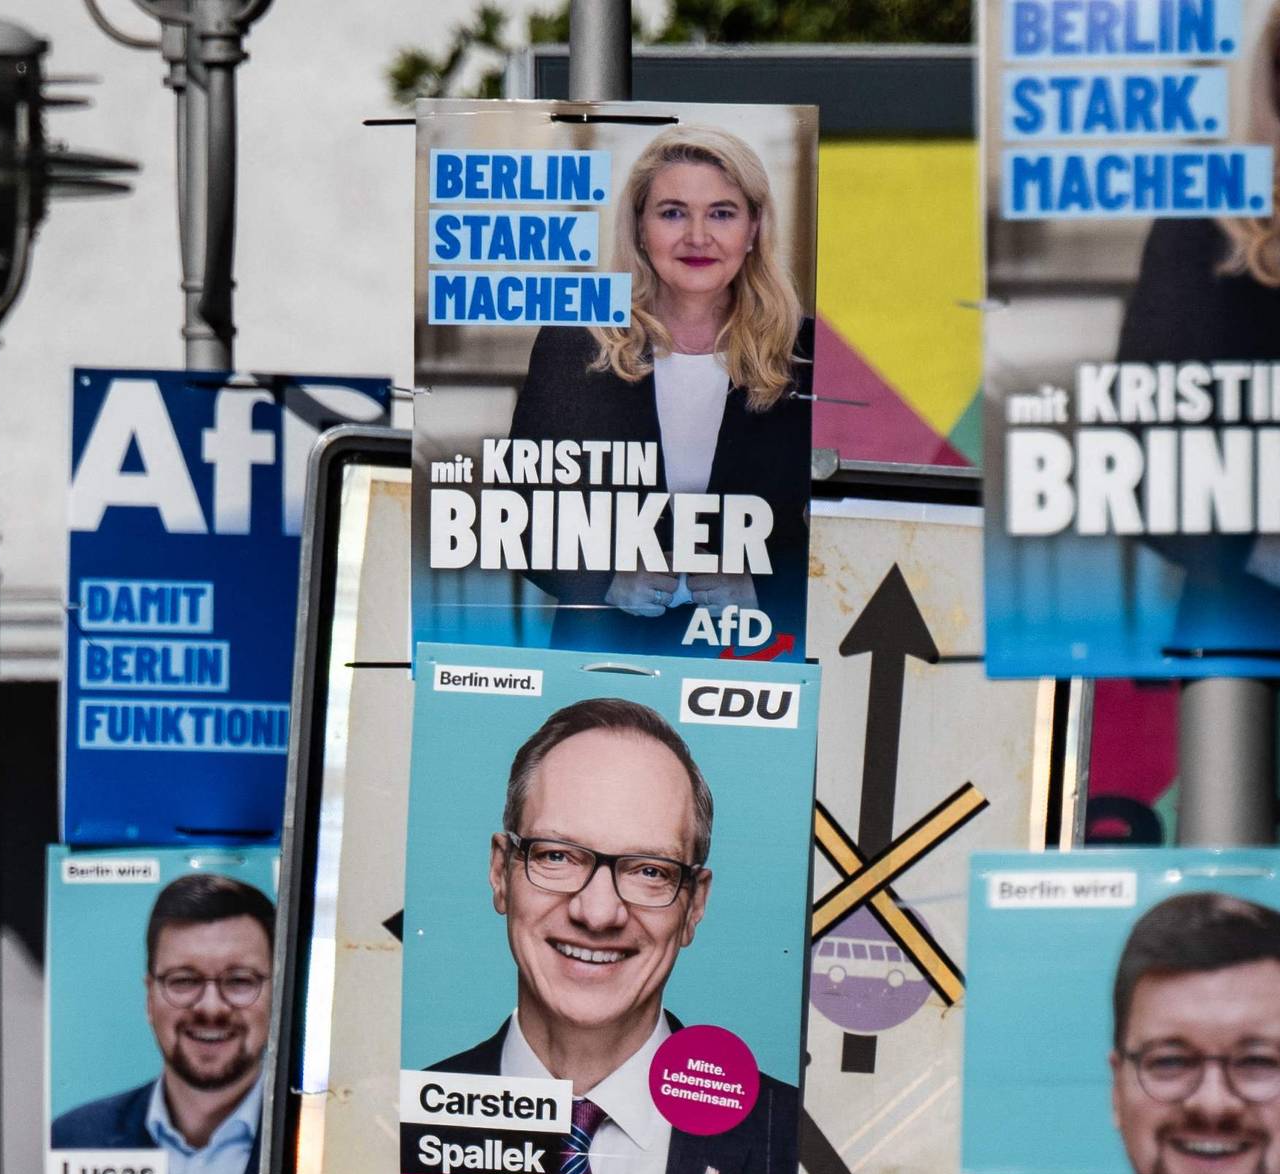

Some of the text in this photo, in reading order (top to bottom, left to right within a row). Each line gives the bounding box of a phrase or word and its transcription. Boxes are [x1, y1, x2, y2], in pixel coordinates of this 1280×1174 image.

[1011, 0, 1235, 55] BERLIN.
[1011, 75, 1218, 133] STARK.
[436, 154, 605, 201] BERLIN.
[1010, 153, 1265, 211] MACHEN.
[436, 214, 591, 263] STARK.
[435, 277, 625, 323] MACHEN.
[1007, 383, 1069, 424] mit
[431, 439, 658, 486] mit KRISTIN
[430, 490, 774, 575] BRINKER
[86, 585, 207, 624] DAMIT
[682, 607, 773, 648] AfD
[85, 646, 221, 685] BERLIN
[439, 671, 537, 693] Berlin wird.
[687, 686, 793, 721] CDU
[998, 879, 1128, 901] Berlin wird.
[662, 1069, 746, 1096] Lebenswert.
[687, 1058, 726, 1078] Mitte.
[418, 1083, 558, 1122] Carsten
[660, 1083, 744, 1111] Gemeinsam.
[418, 1134, 546, 1174] Spallek
